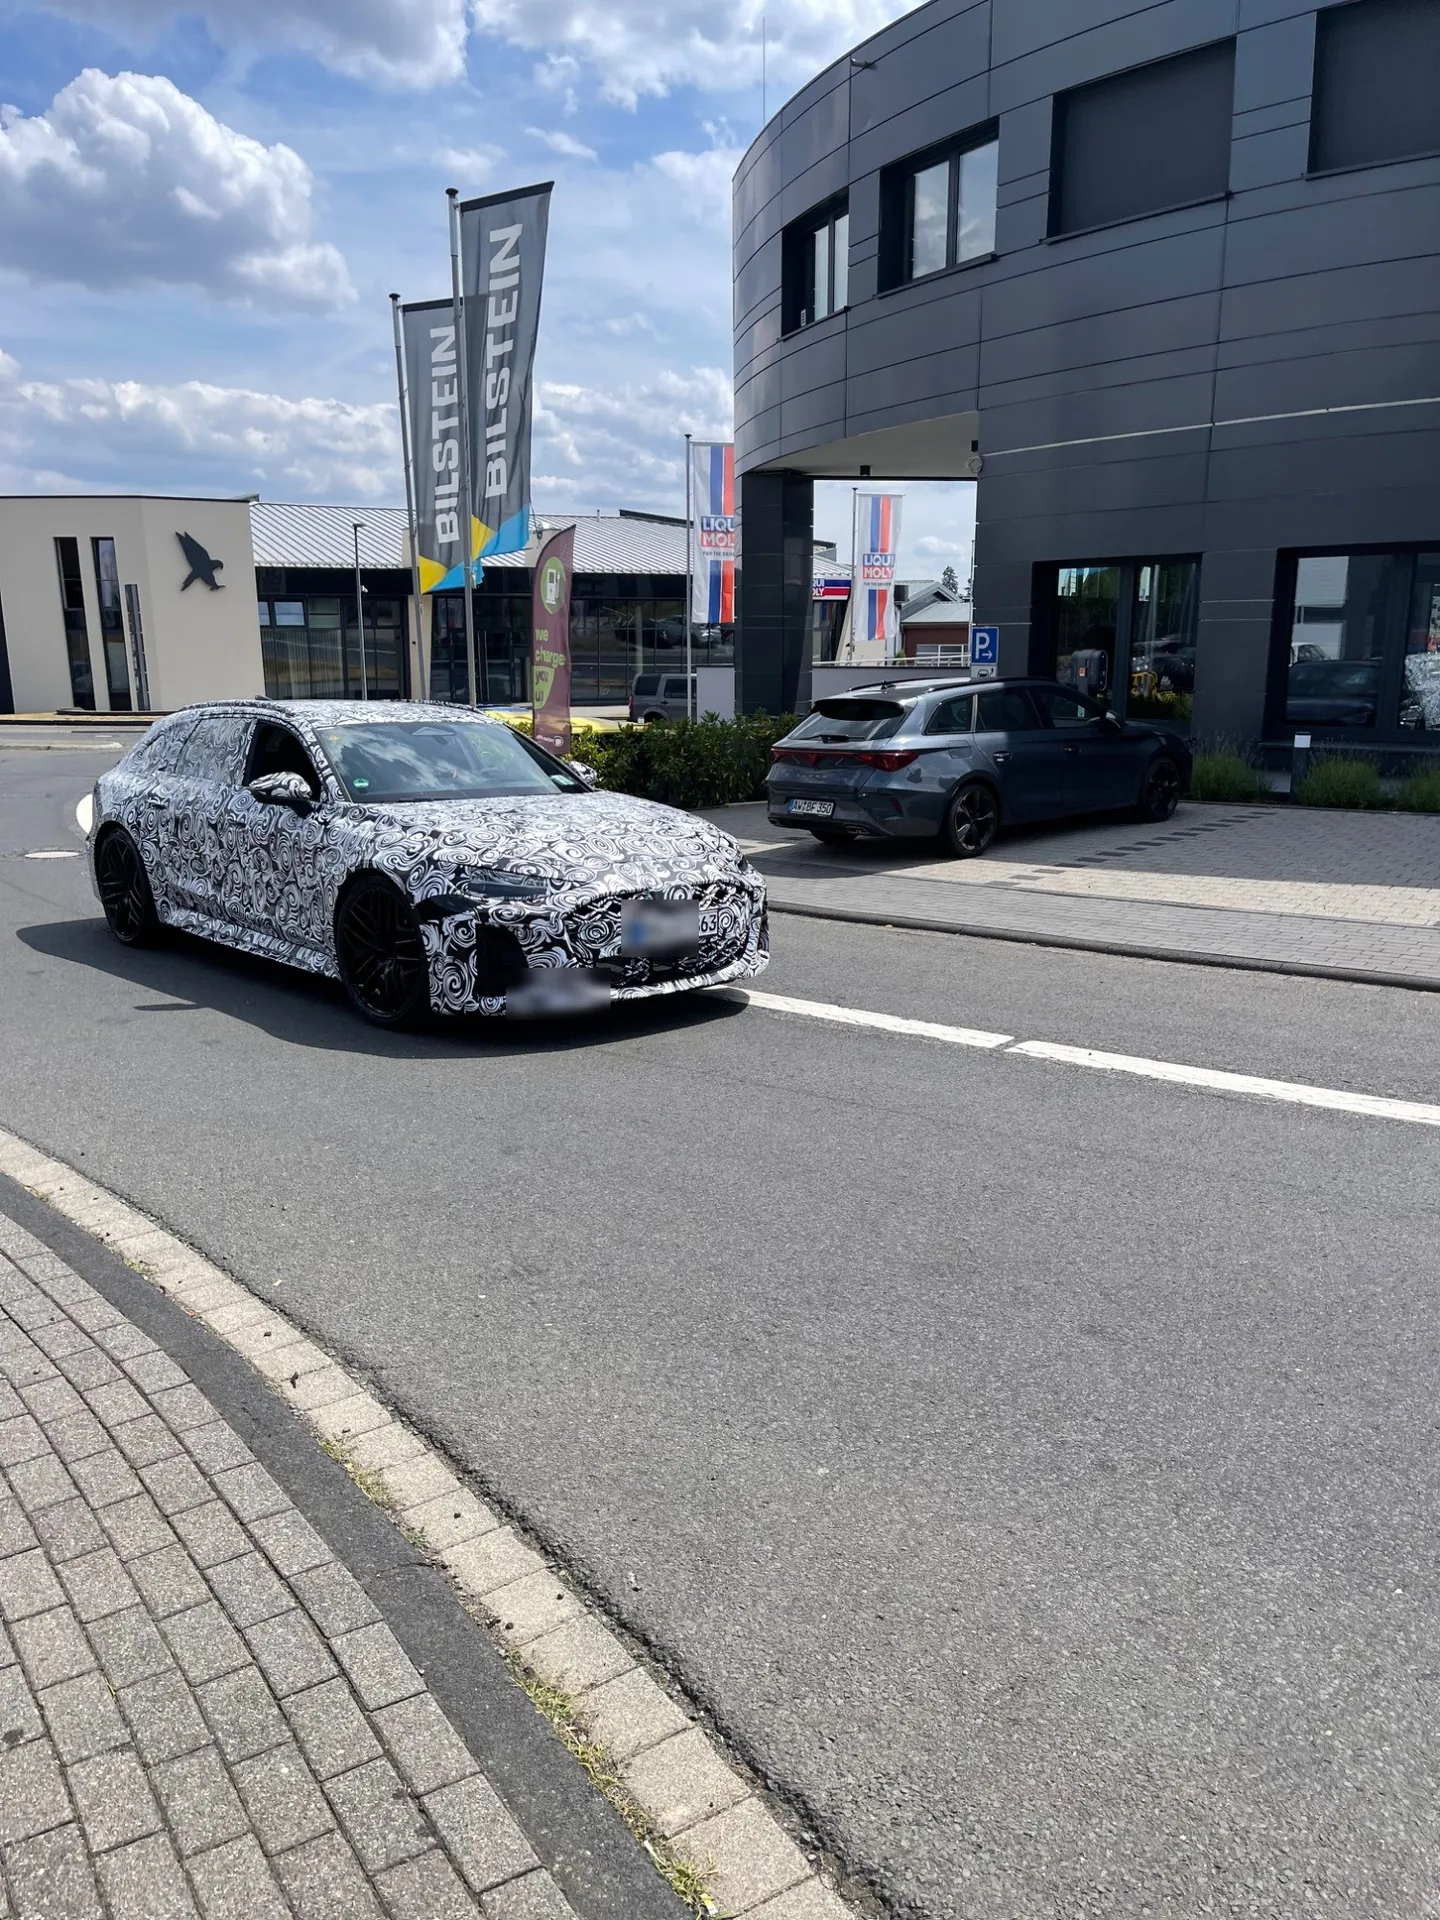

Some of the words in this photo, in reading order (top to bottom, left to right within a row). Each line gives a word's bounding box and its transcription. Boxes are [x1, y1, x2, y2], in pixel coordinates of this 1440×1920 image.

[485, 223, 523, 498] BILSTEIN
[430, 325, 460, 544] BILSTEIN
[702, 517, 735, 532] LIQU
[702, 532, 735, 547] MOL
[864, 554, 894, 566] LIQUI
[863, 567, 894, 578] MOLY
[535, 629, 549, 642] we
[975, 632, 990, 660] P
[535, 645, 567, 668] charge
[807, 801, 817, 812] BF
[817, 802, 832, 814] 350
